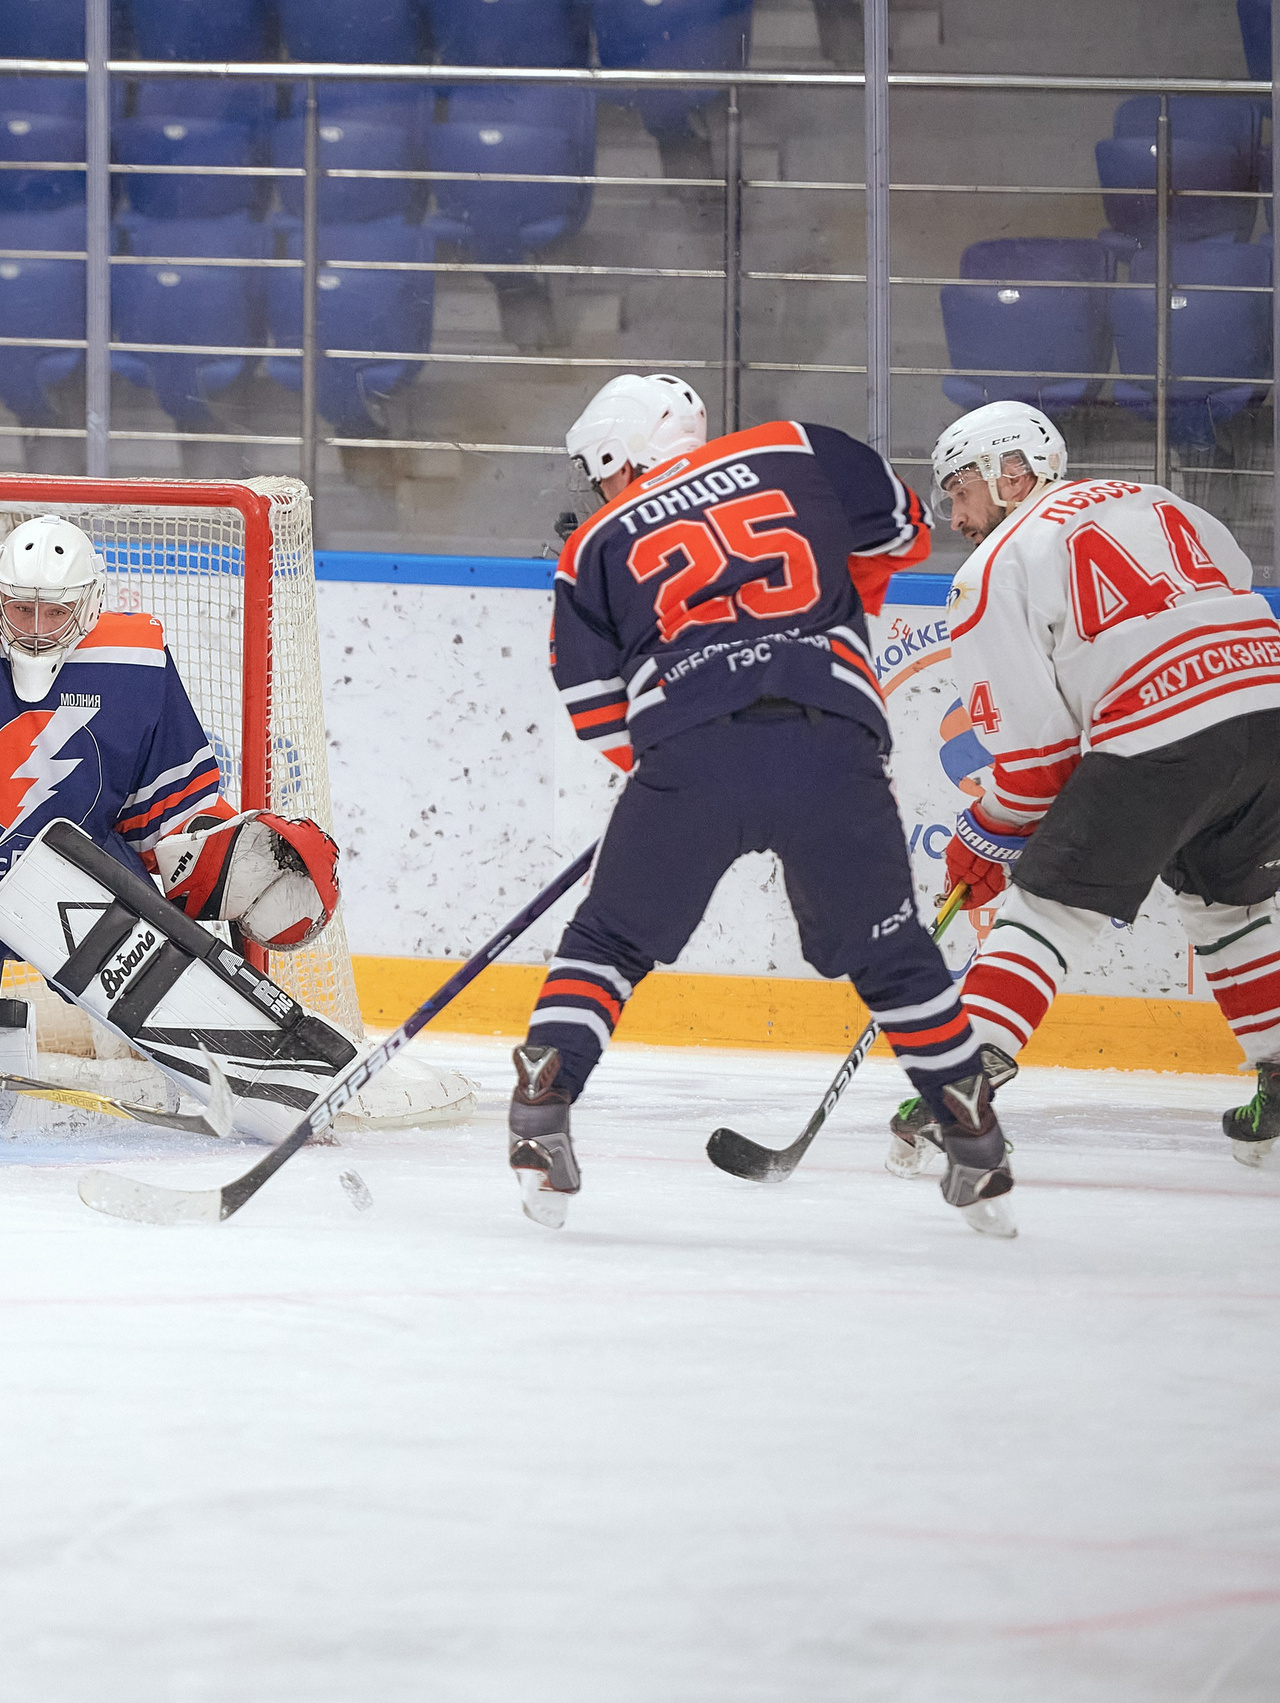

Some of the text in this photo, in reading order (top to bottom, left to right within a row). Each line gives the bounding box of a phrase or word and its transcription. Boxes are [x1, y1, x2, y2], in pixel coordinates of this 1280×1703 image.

[992, 434, 1020, 446] CCM
[619, 463, 761, 535] ГОНЦОВ
[626, 489, 821, 643] 25
[1066, 501, 1252, 643] 44
[726, 643, 772, 672] ГЭС
[875, 620, 949, 681] ХОККЕ
[1138, 640, 1280, 706] ЯКУТСКЭНЕ
[60, 693, 101, 708] МОЛНИЯ
[100, 930, 156, 999] Brian's
